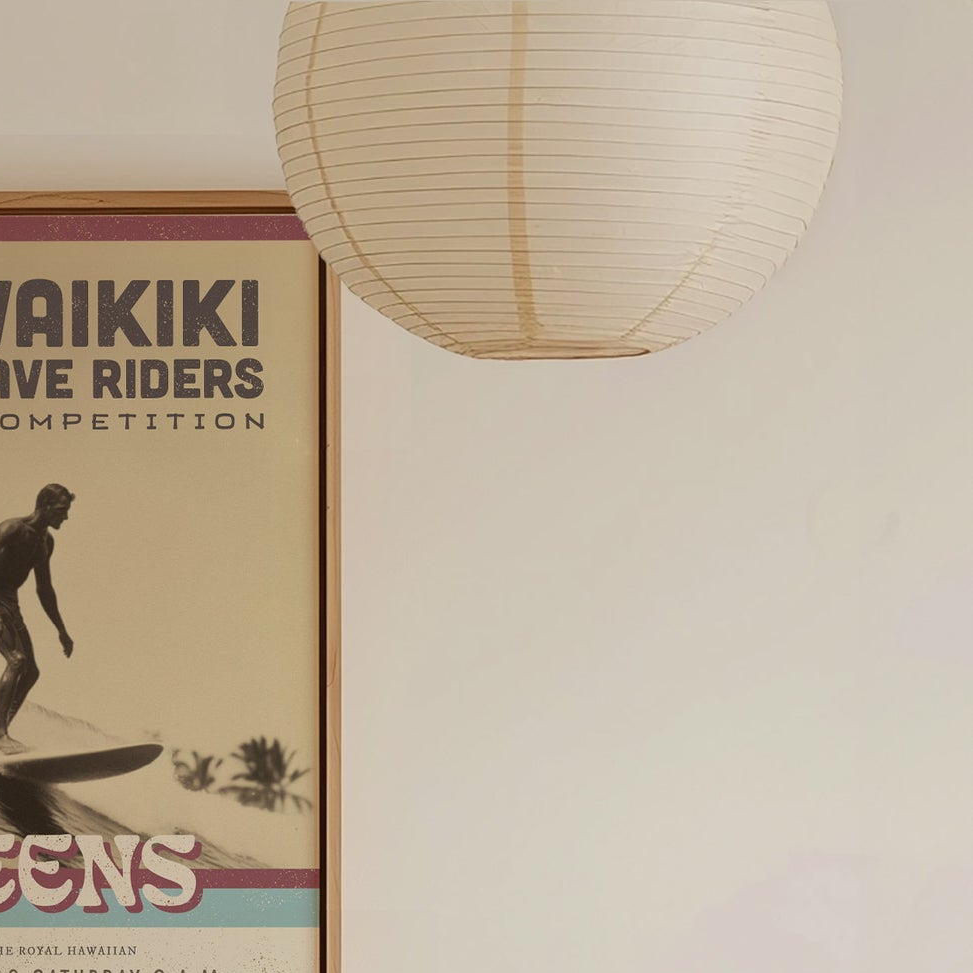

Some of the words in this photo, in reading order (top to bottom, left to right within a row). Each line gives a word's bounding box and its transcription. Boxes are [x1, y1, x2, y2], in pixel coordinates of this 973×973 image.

[93, 358, 265, 399] RIDERS
[18, 946, 62, 956] ROYAL
[67, 946, 138, 956] HAWAIIAN
